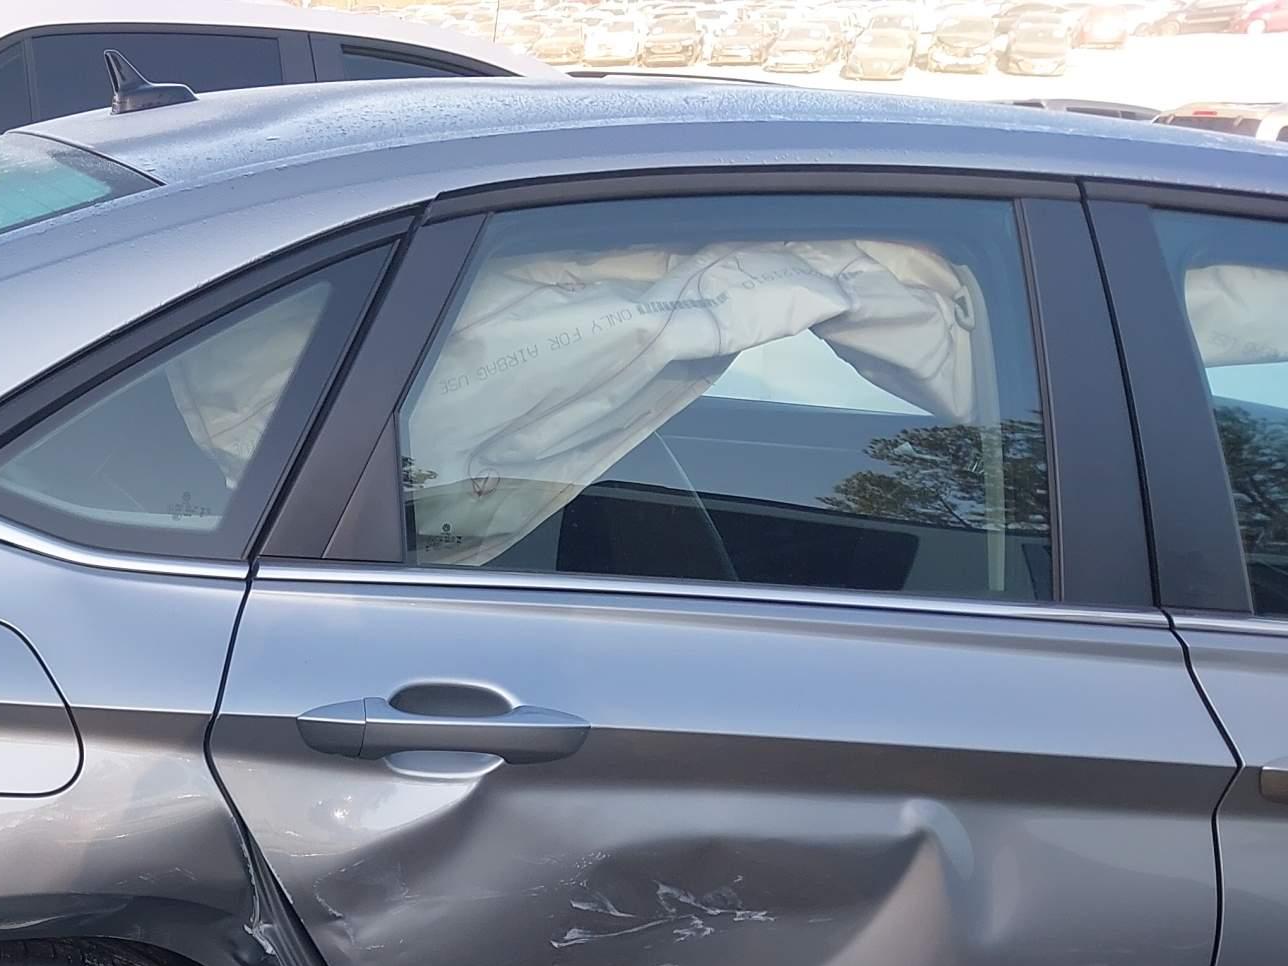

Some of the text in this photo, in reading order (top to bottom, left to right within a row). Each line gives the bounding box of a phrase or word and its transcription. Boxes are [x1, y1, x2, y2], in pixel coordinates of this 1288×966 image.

[439, 308, 633, 395] ONLY FOR AIRBAG USE
